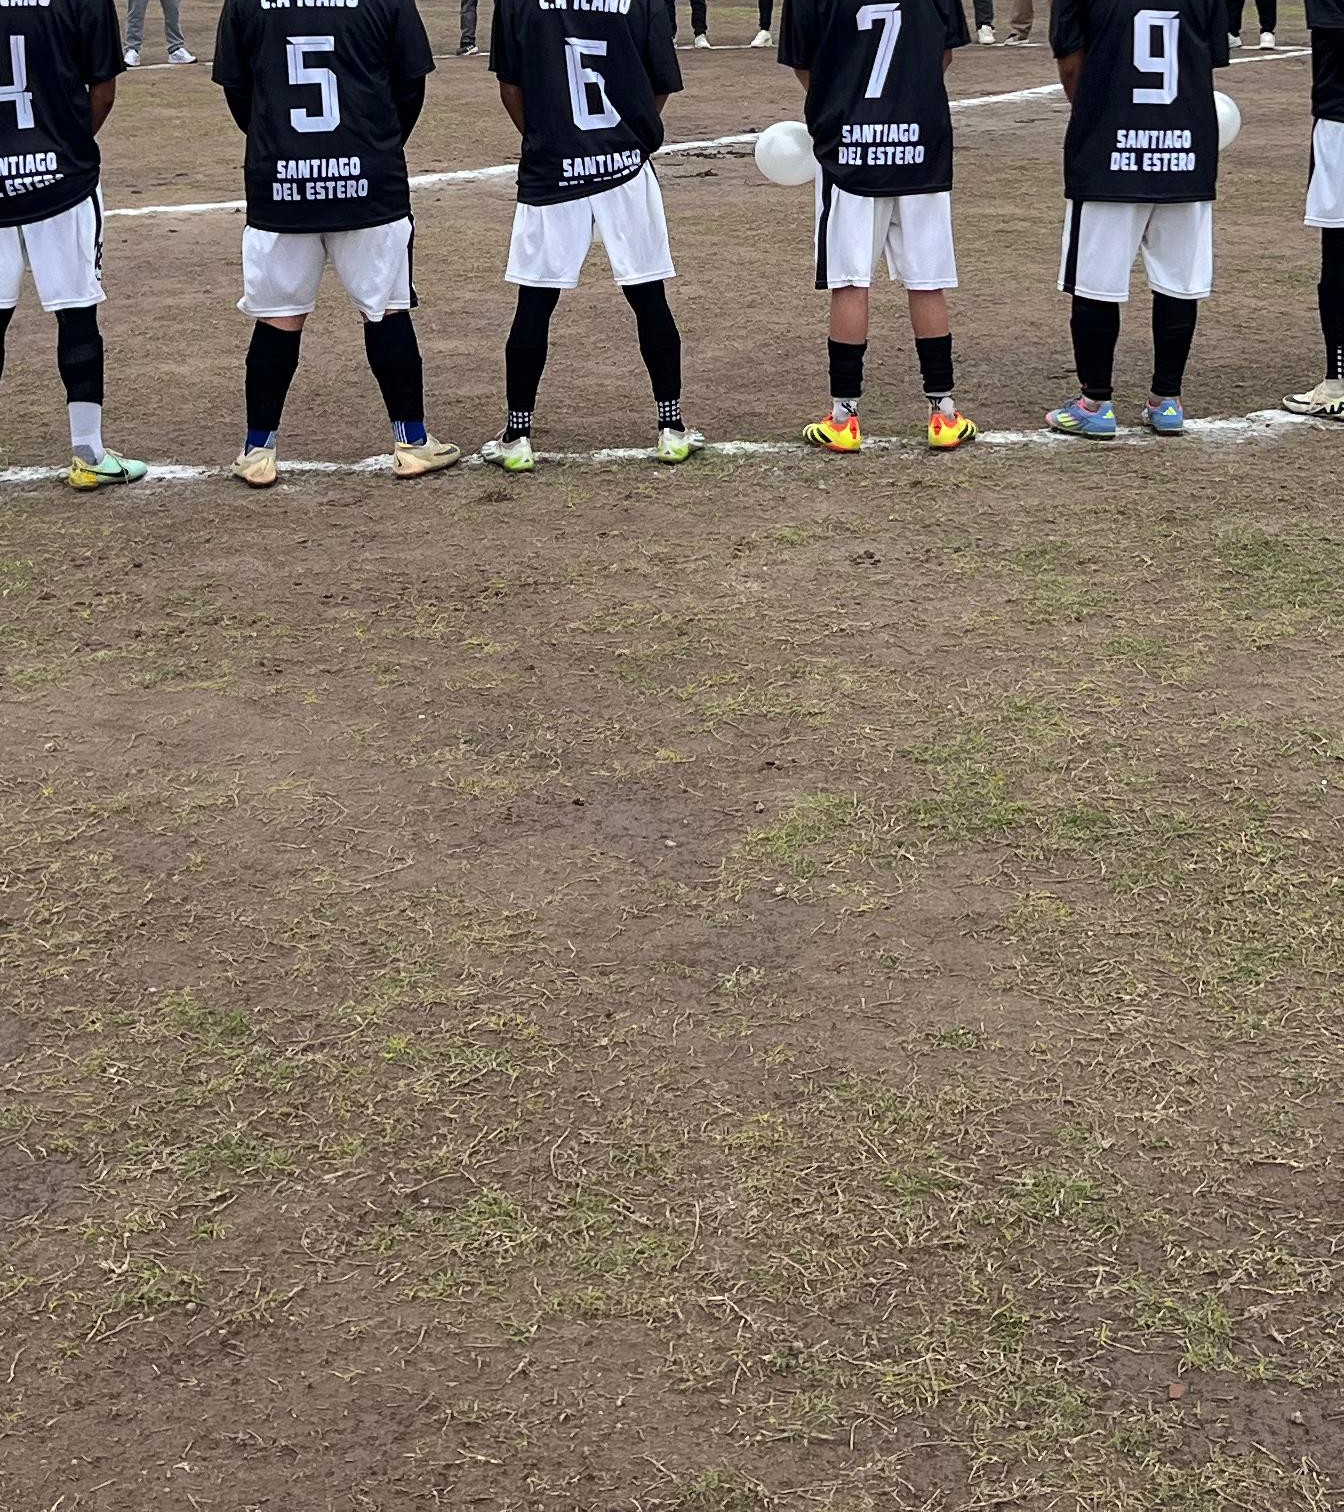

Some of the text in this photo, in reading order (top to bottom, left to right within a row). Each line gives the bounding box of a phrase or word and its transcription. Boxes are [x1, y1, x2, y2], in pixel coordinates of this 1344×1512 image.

[856, 2, 902, 99] 7
[1132, 9, 1180, 105] 9
[286, 35, 341, 134] 5
[564, 37, 622, 131] 6
[841, 123, 920, 144] SANTIAGO
[1116, 129, 1192, 149] SANTIAGO
[562, 148, 641, 178] SANTIAGO
[838, 145, 925, 166] DEL ESTERO
[1109, 152, 1196, 172] DEL ESTERO
[276, 156, 361, 179] SANTIAGO
[272, 179, 369, 201] DEL ESTERO
